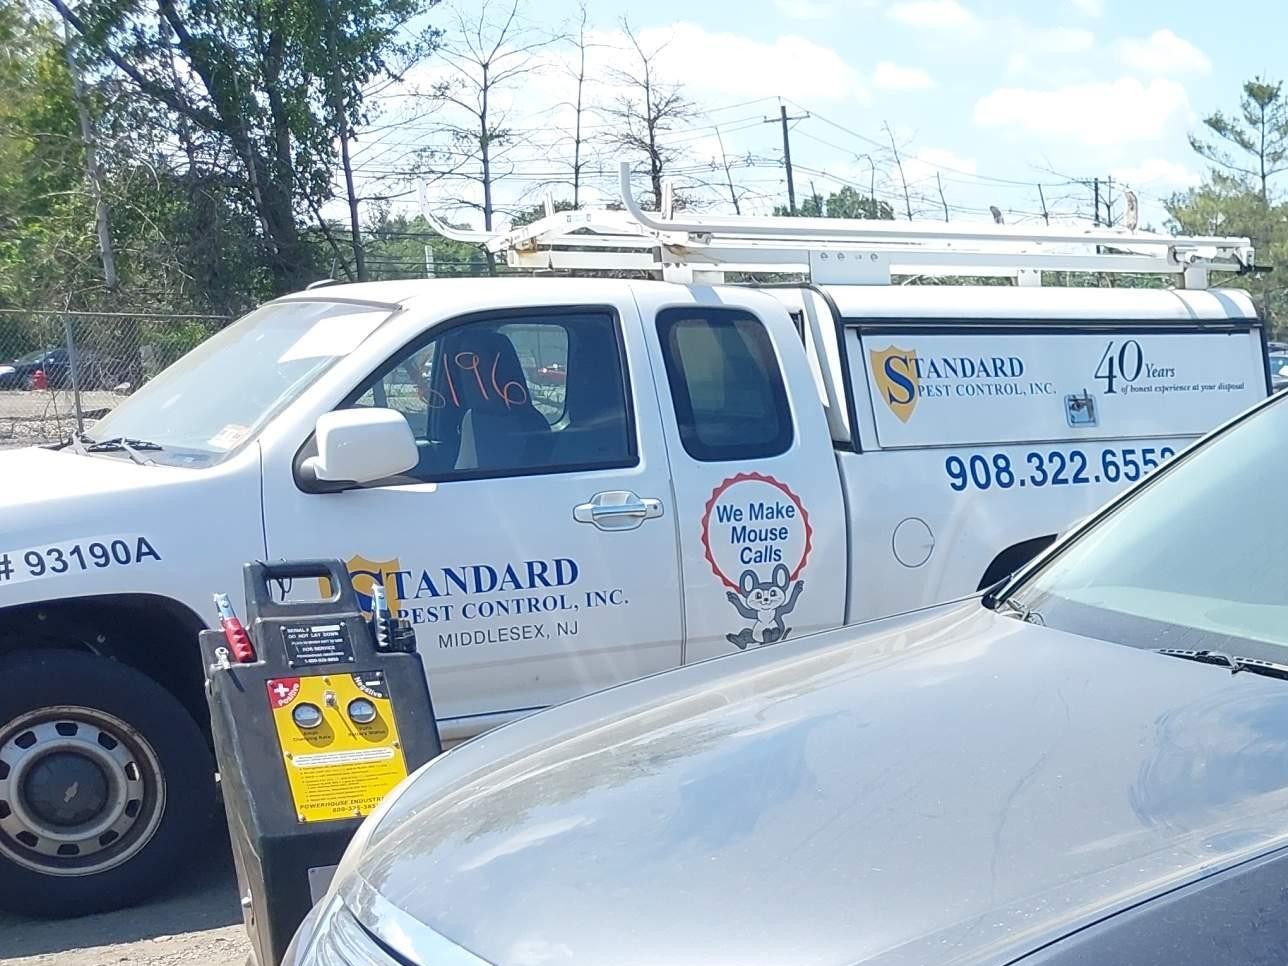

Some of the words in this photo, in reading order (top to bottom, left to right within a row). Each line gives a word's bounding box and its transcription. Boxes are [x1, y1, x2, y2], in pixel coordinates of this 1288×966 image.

[1094, 339, 1143, 394] 40
[1145, 363, 1175, 378] Years
[884, 355, 1024, 405] STANDARD
[918, 384, 951, 397] PEST
[956, 383, 1026, 397] CONTROL,
[1030, 382, 1057, 395] INC.
[1121, 384, 1129, 395] of
[1130, 384, 1152, 393] honest
[1154, 384, 1190, 394] experience
[1192, 383, 1199, 391] at
[1201, 384, 1216, 394] your
[1218, 382, 1245, 392] disposal
[716, 504, 743, 523] We
[749, 501, 795, 521] Make
[731, 525, 788, 544] Mouse
[24, 536, 162, 577] 93190A
[740, 545, 782, 564] Calls
[397, 605, 454, 625] PEST
[461, 593, 579, 620] CONTROL,
[585, 589, 629, 608] INC.
[438, 623, 550, 649] MIDDLESEX,
[557, 621, 579, 637] NJ
[278, 683, 299, 706] Positive
[354, 676, 382, 698] Negative
[300, 799, 348, 809] POWERHOUSE
